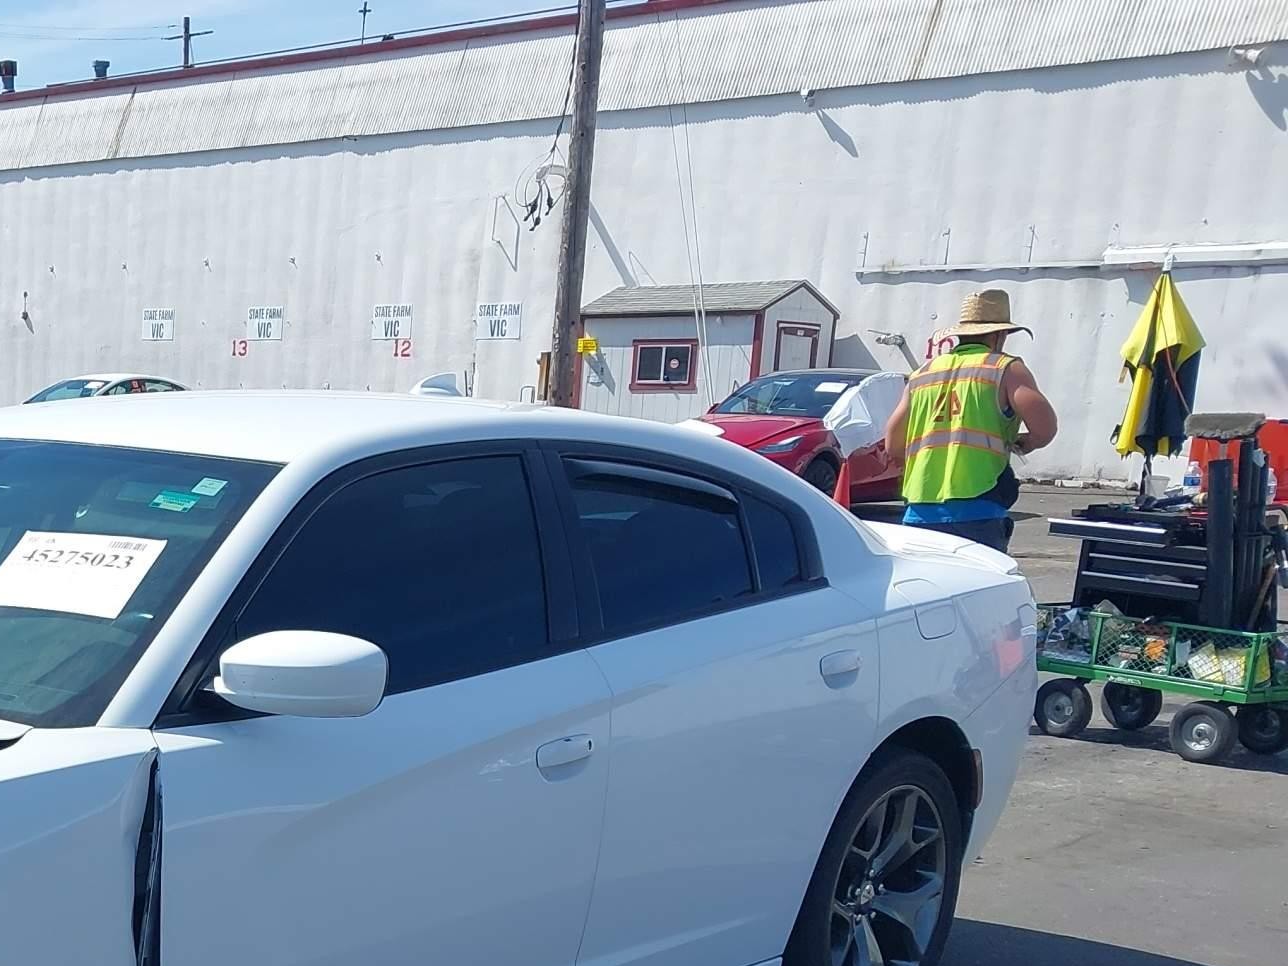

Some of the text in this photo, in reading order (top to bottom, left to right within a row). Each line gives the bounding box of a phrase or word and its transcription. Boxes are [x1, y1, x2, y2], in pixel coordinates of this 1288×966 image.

[144, 310, 174, 320] STATE FARM
[249, 308, 282, 320] STATE FARM
[374, 305, 411, 318] STATE FARM
[478, 303, 520, 317] STATE FARM
[152, 323, 164, 338] VIC
[258, 322, 272, 338] VIC
[384, 320, 400, 337] VIC
[489, 319, 507, 337] VIC
[232, 340, 248, 356] 13
[393, 339, 411, 357] 12
[22, 549, 134, 569] 45275023
